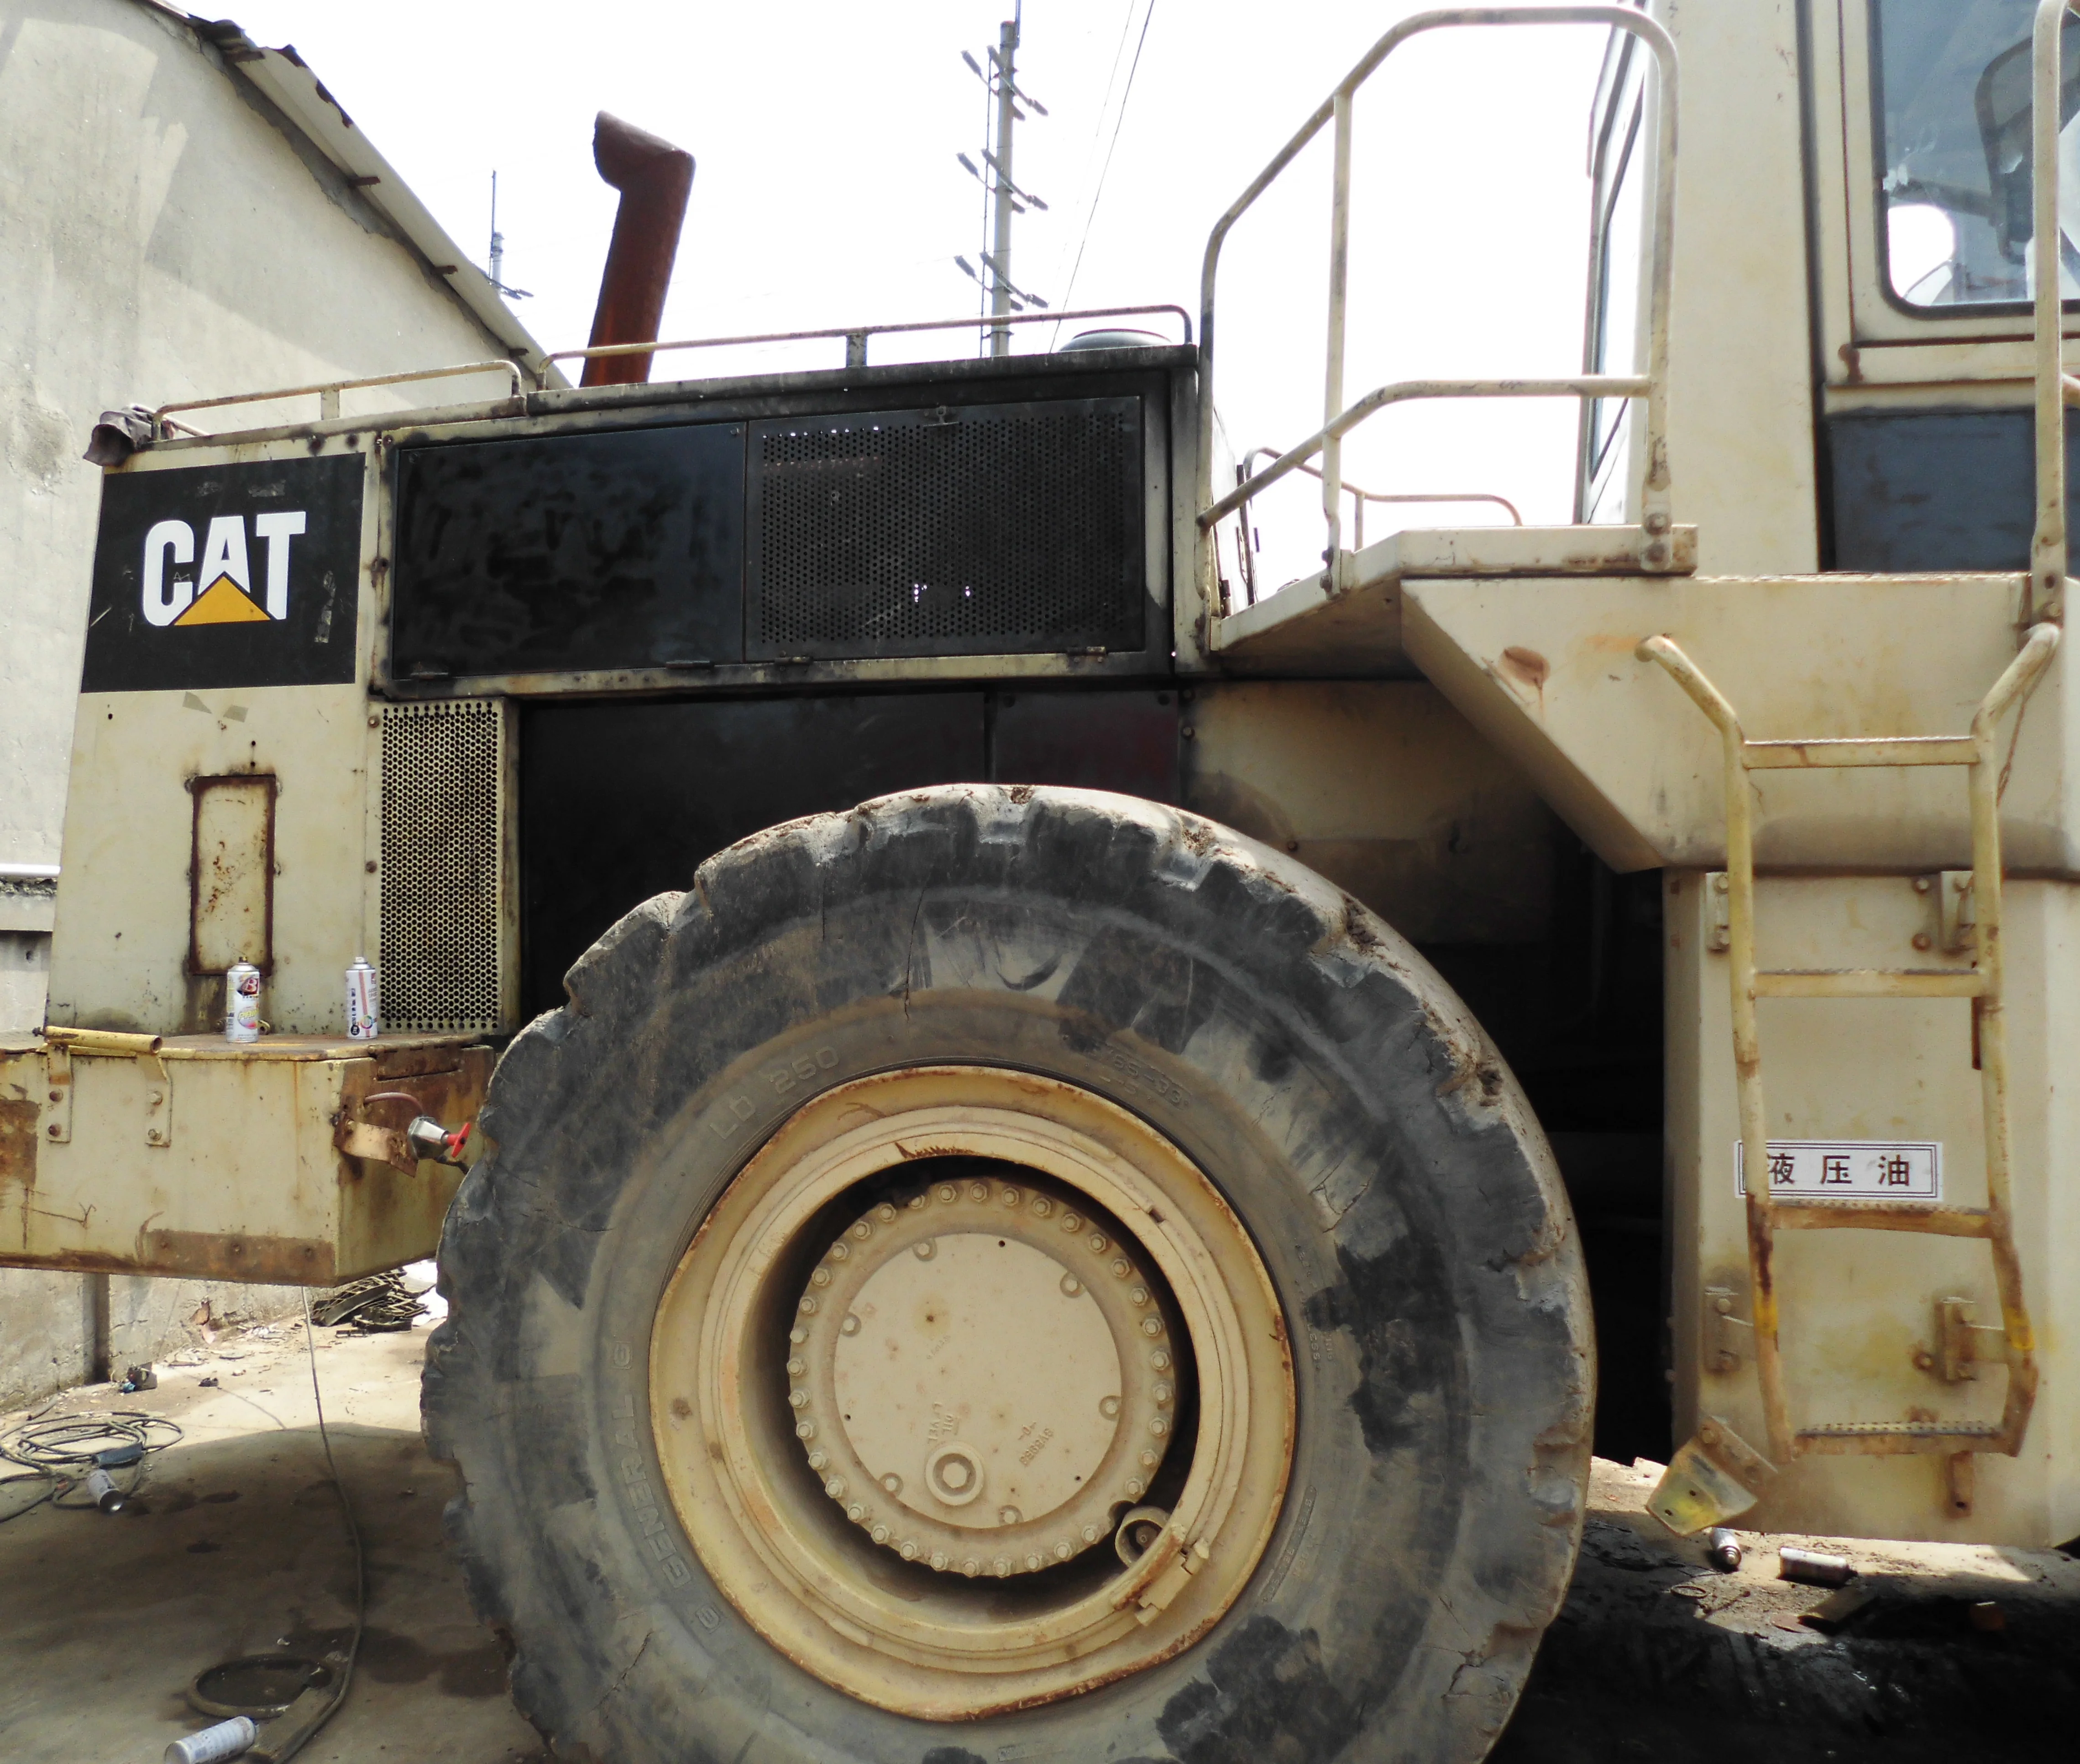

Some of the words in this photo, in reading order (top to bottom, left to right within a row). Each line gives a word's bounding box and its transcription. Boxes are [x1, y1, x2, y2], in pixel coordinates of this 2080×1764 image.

[143, 511, 306, 626] CAT
[709, 1096, 756, 1140] LD
[768, 1045, 839, 1094] 250
[1766, 1152, 1910, 1186] 液压油
[613, 1394, 691, 1589] GENERAL
